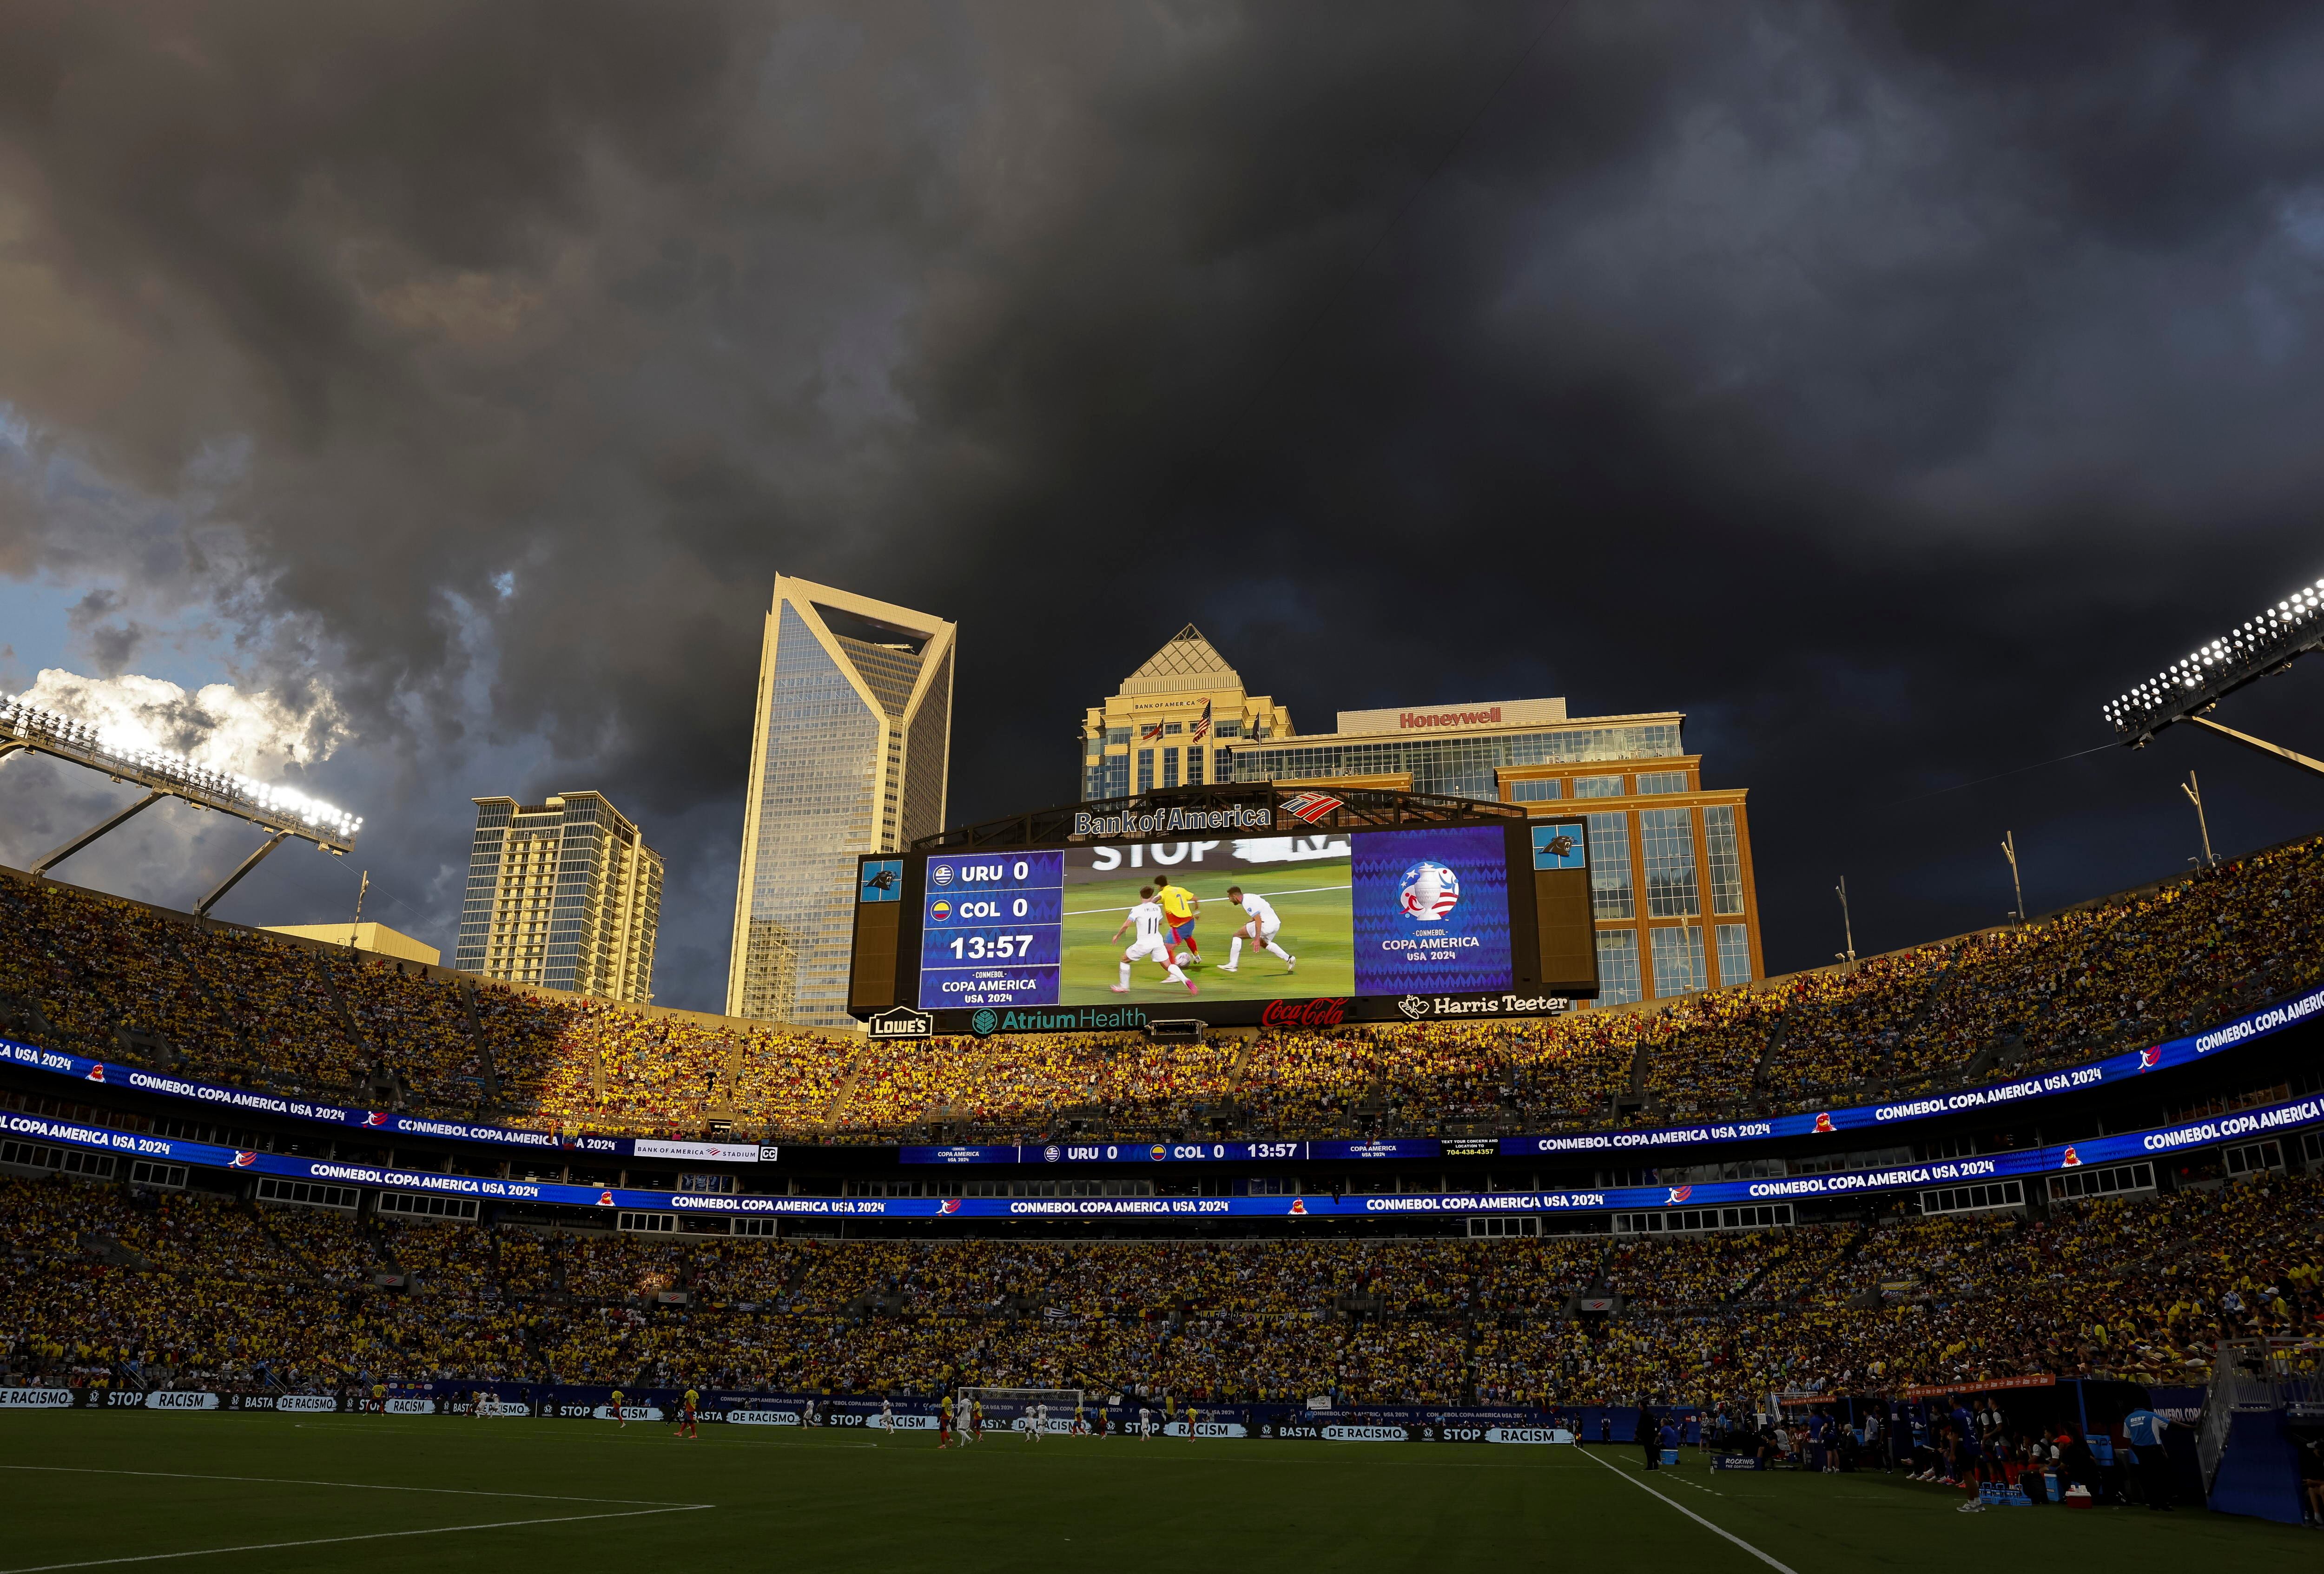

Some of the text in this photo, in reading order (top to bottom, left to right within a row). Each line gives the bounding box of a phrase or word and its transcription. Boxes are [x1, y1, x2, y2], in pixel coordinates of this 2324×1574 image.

[1400, 707, 1501, 728] Honeywell
[1075, 803, 1271, 835] Bank of America
[962, 862, 1029, 882] URU 0
[960, 898, 1028, 918] COL 0
[950, 935, 1033, 959] 13:57
[1382, 936, 1479, 950] COPA AMERICA
[1407, 951, 1456, 961] USA 2024
[942, 979, 1037, 992] COPA AMERICA
[964, 993, 1012, 1003] USA 2024
[1434, 994, 1568, 1014] Harris Teeter
[1002, 1008, 1147, 1029] Atrium Health
[1262, 997, 1349, 1027] Coca-Cola
[2196, 1008, 2288, 1053] CONMEBOL COPA
[15, 1047, 38, 1064] USA
[41, 1053, 72, 1071] 2024
[130, 1073, 345, 1121] CONMEBOL COPA AMERICA USA 2024
[1875, 1067, 2102, 1120] CONMEBOL COPA AMERICA USA 2024
[2144, 1124, 2220, 1150] CONMEBOL
[2221, 1115, 2260, 1135] COPA
[2260, 1101, 2320, 1128] AMERICA
[10, 1118, 47, 1135] COPA
[48, 1125, 108, 1146] AMERICA
[112, 1135, 135, 1150] USA
[138, 1139, 170, 1154] 2024
[398, 1120, 469, 1138] CONMEBOL
[470, 1128, 504, 1141] COPA
[504, 1132, 559, 1146] AMERICA
[587, 1139, 615, 1151] 2024
[1538, 1124, 1770, 1151] CONMEBOL COPA AMERICA USA 2024
[763, 1150, 775, 1158] CC
[1068, 1146, 1117, 1159] URU 0
[1174, 1145, 1224, 1159] COL 0
[1248, 1143, 1297, 1158] 13:57
[310, 1164, 539, 1198] CONMEBOL COPA AMERICA USA 2024
[1750, 1161, 1994, 1197] CONMEBOL COPA AMERICA USA 2024
[672, 1196, 885, 1213] CONMEBOL COPA AMERICA USA 2024
[1010, 1201, 1228, 1213] CONMEBOL COPA AMERICA USA 2024
[1367, 1194, 1603, 1211] CONMEBOL COPA AMERICA USA 2024
[11, 1391, 68, 1404] RACISMO
[107, 1392, 205, 1407] STOP RACISM
[245, 1397, 333, 1409] BASTA DE RACISMO
[394, 1401, 425, 1412] RACISM
[560, 1406, 648, 1419] STOP RCISM
[733, 1412, 746, 1421] DE
[749, 1413, 795, 1423] RACISMO
[830, 1414, 863, 1426] STOP
[1280, 1427, 1402, 1438] BASTA DE RACISMO
[1443, 1429, 1554, 1441] STOP RACISM
